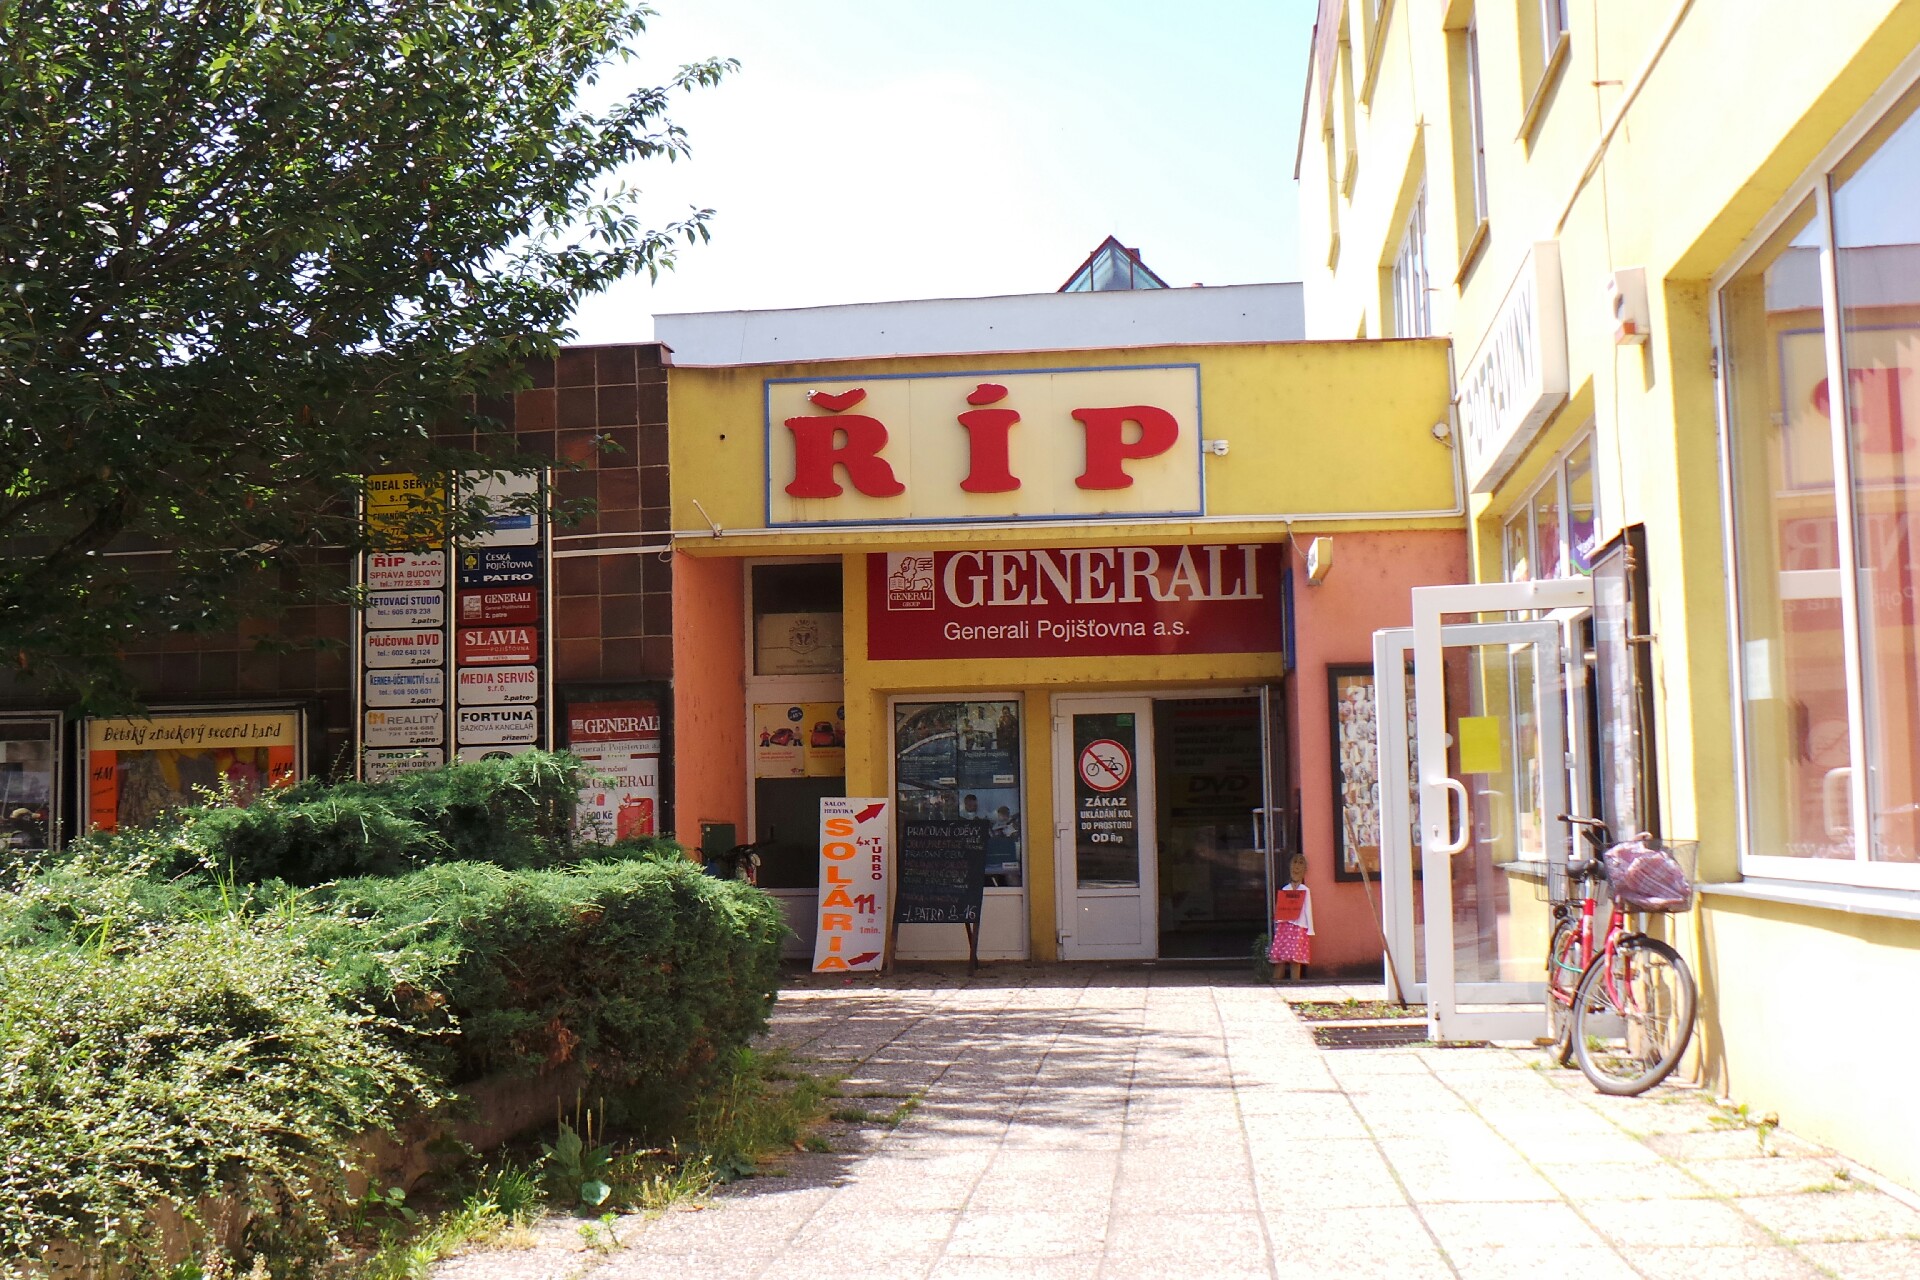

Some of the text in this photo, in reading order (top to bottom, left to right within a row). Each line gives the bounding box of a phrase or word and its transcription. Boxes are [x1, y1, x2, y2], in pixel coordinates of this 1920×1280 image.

[784, 383, 1180, 499] ŘÍP
[374, 554, 406, 568] ŘÍP
[486, 552, 511, 561] ČESKÁ
[370, 569, 442, 580] SPRÁVA BUDOVY
[483, 573, 534, 582] PATRO
[943, 543, 1263, 609] GENERALI
[485, 593, 531, 604] GENERALI
[889, 591, 934, 603] GENERALI
[944, 617, 1191, 645] Generali Pojišťovna a.s.
[370, 634, 440, 647] PŮJČOVNA DVD
[465, 630, 529, 646] SLAVIA
[461, 673, 494, 685] MEDIA
[387, 715, 438, 724] REALITY
[461, 712, 534, 722] FORTUNA
[207, 723, 248, 739] second
[1085, 796, 1127, 807] ZÁKAZ
[1080, 808, 1133, 819] UKLÁDÁNÍ KOL
[1081, 821, 1132, 830] DO PROSTORU
[1091, 833, 1109, 843] OD
[871, 837, 883, 881] TURBO
[816, 818, 857, 970] SOLÁRIA
